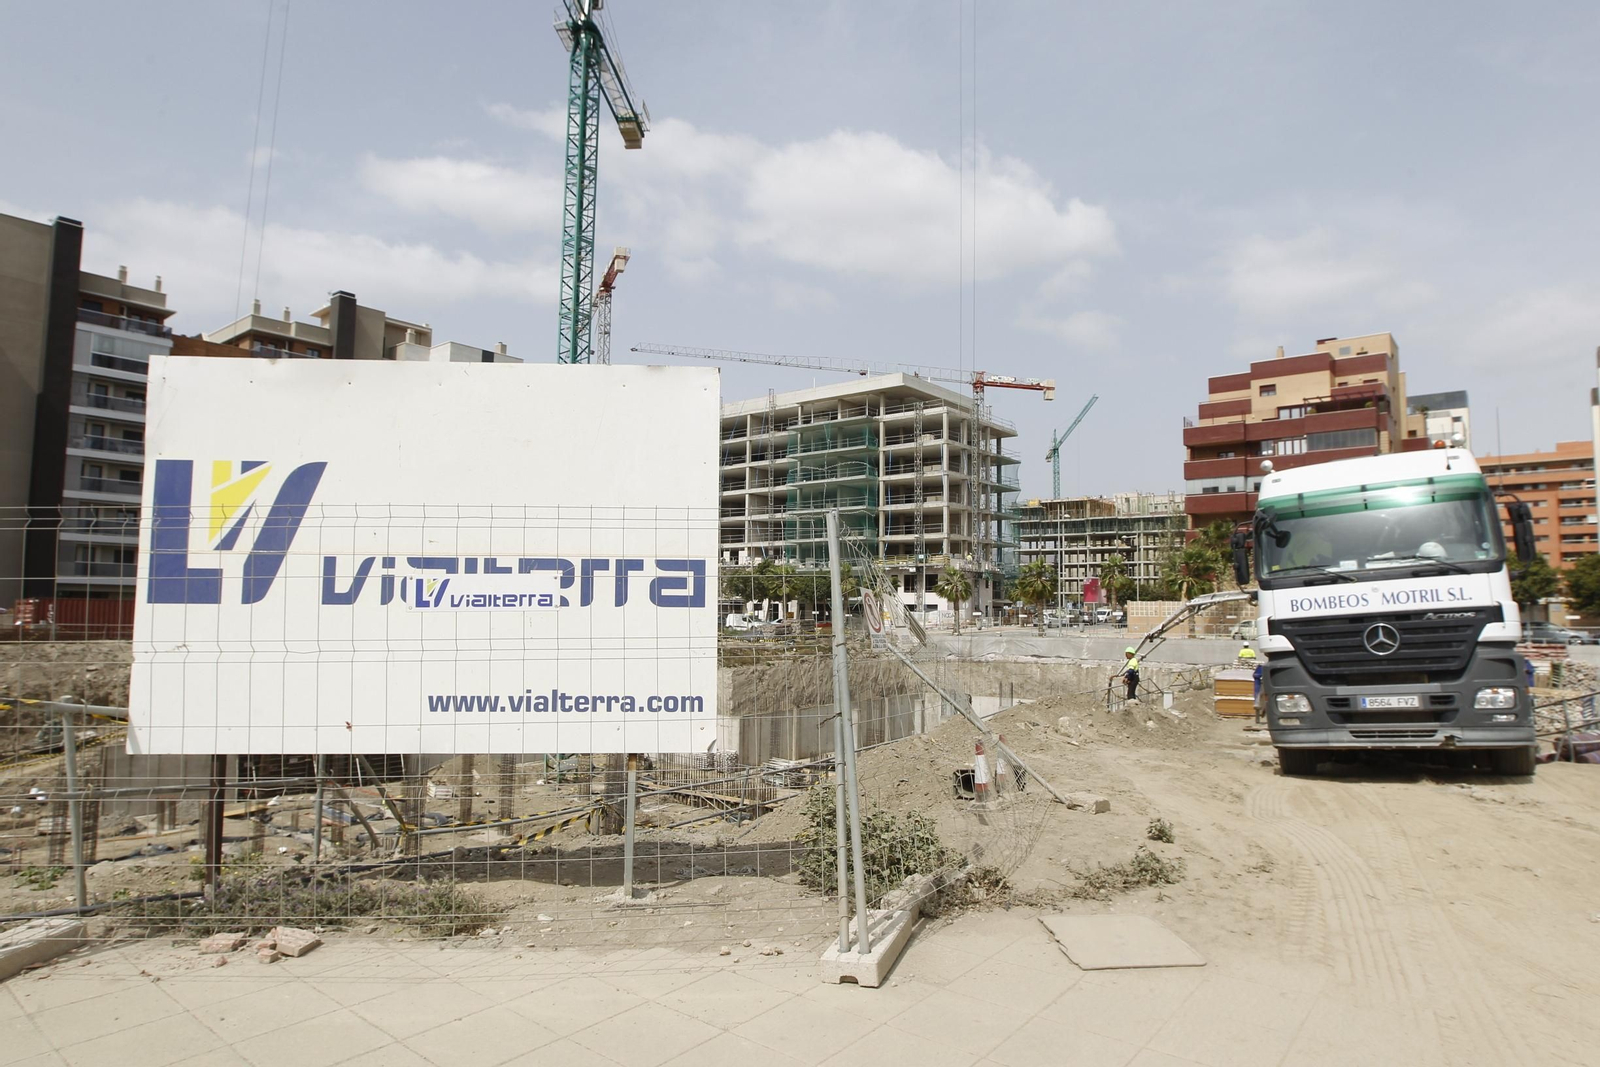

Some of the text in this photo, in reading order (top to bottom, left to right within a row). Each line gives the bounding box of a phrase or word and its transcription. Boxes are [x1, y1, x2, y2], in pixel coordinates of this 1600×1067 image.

[450, 594, 553, 607] vialterra
[1290, 587, 1473, 612] BOMBEOS MOTRIL S.L.
[428, 689, 704, 713] www.vialterra.com
[1369, 698, 1392, 706] 8564
